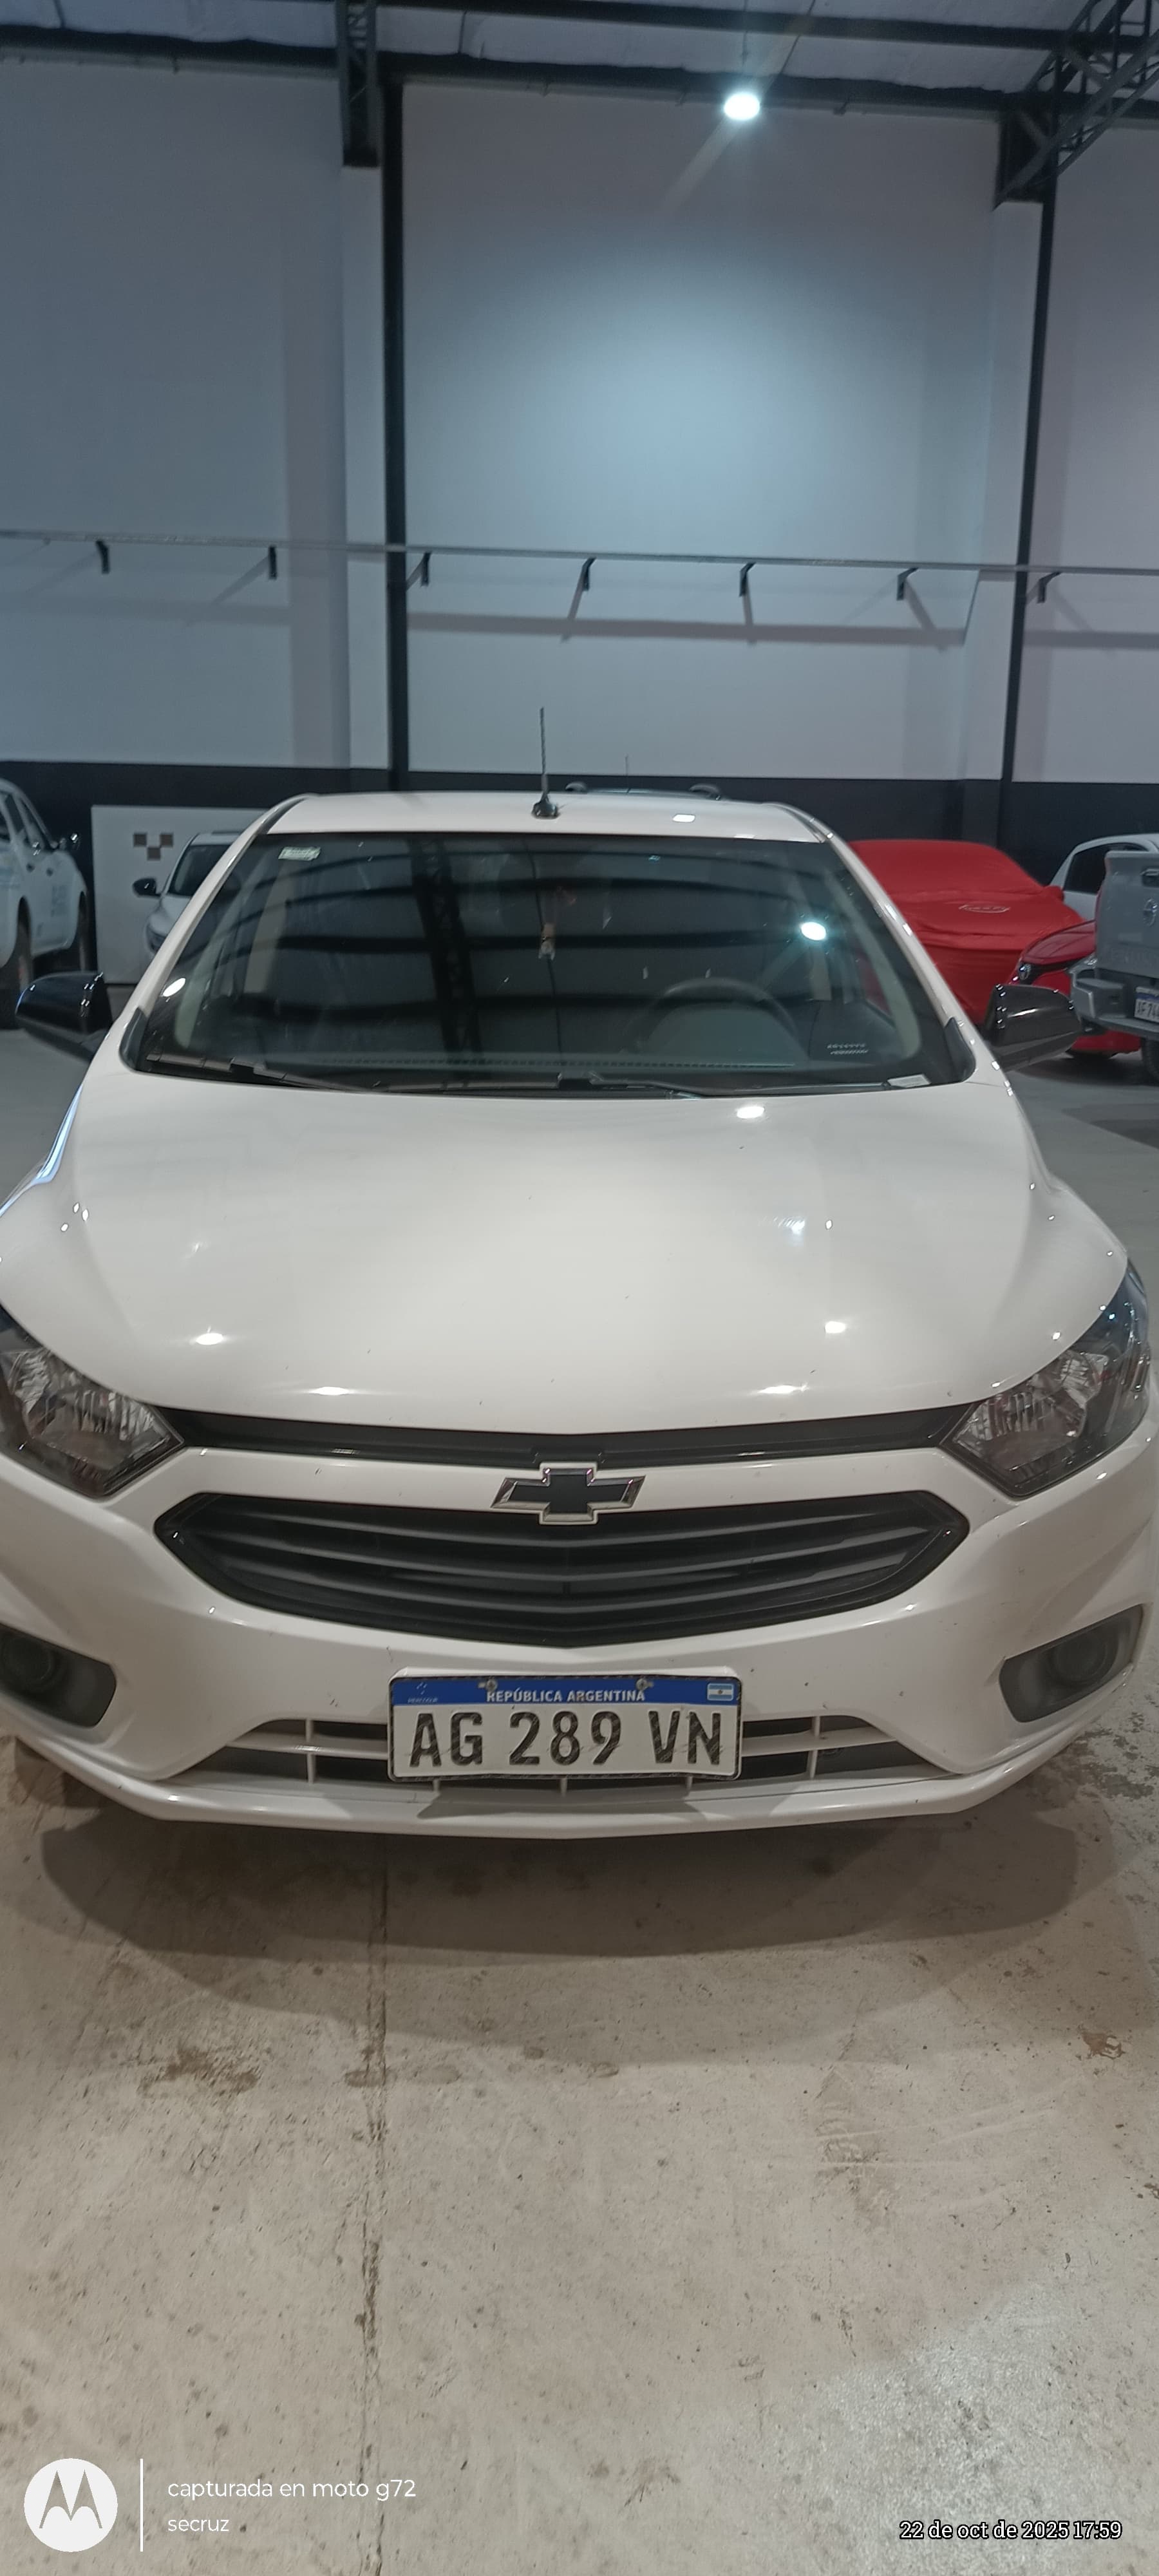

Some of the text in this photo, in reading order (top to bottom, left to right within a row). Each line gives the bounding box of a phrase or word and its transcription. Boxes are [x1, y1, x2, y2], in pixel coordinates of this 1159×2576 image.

[487, 1687, 645, 1702] REPÚBLICA ARGENTINA
[410, 1710, 721, 1767] AG 289 VN
